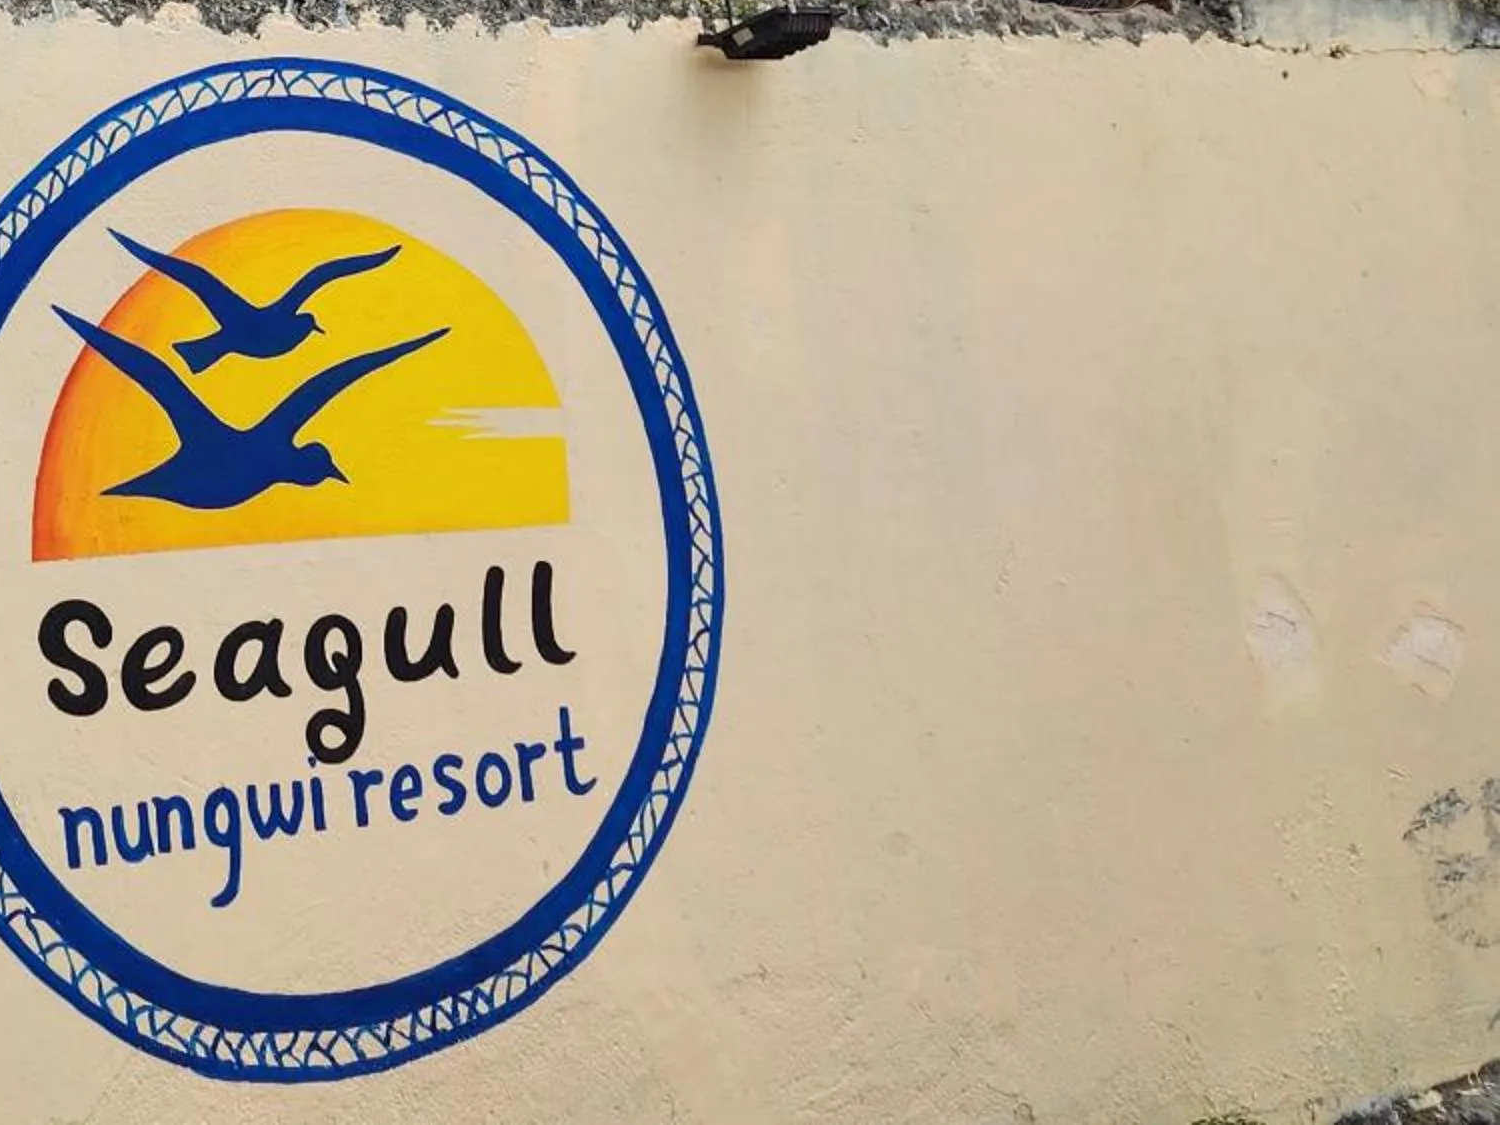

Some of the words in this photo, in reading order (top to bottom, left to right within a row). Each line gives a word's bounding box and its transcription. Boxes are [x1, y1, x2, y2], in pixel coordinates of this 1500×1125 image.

[38, 560, 577, 765] Seagull
[58, 756, 327, 908] nungwi
[351, 706, 597, 828] resort
